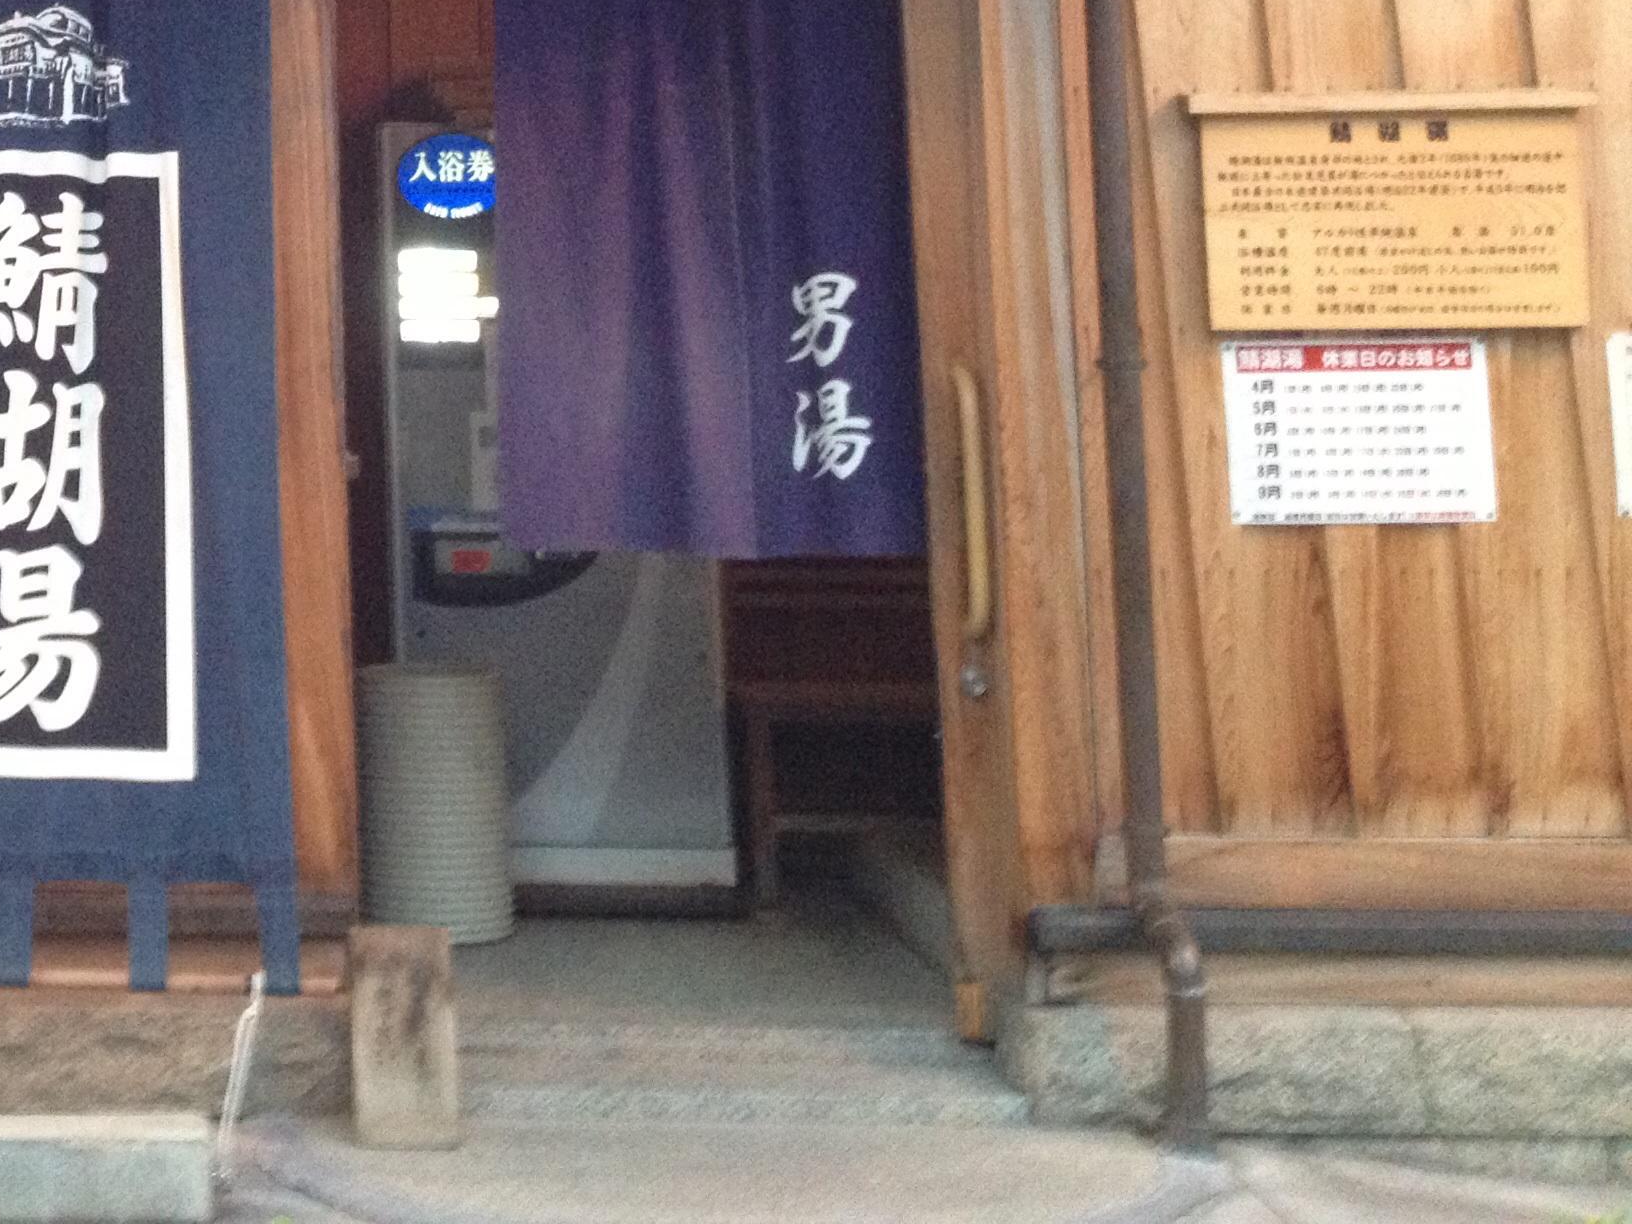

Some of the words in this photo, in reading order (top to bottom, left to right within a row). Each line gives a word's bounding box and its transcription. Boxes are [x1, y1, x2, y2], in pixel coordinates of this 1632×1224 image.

[409, 149, 495, 182] 入浴券
[1322, 350, 1470, 368] 休業日のお知らせ
[785, 272, 872, 480] 男湯
